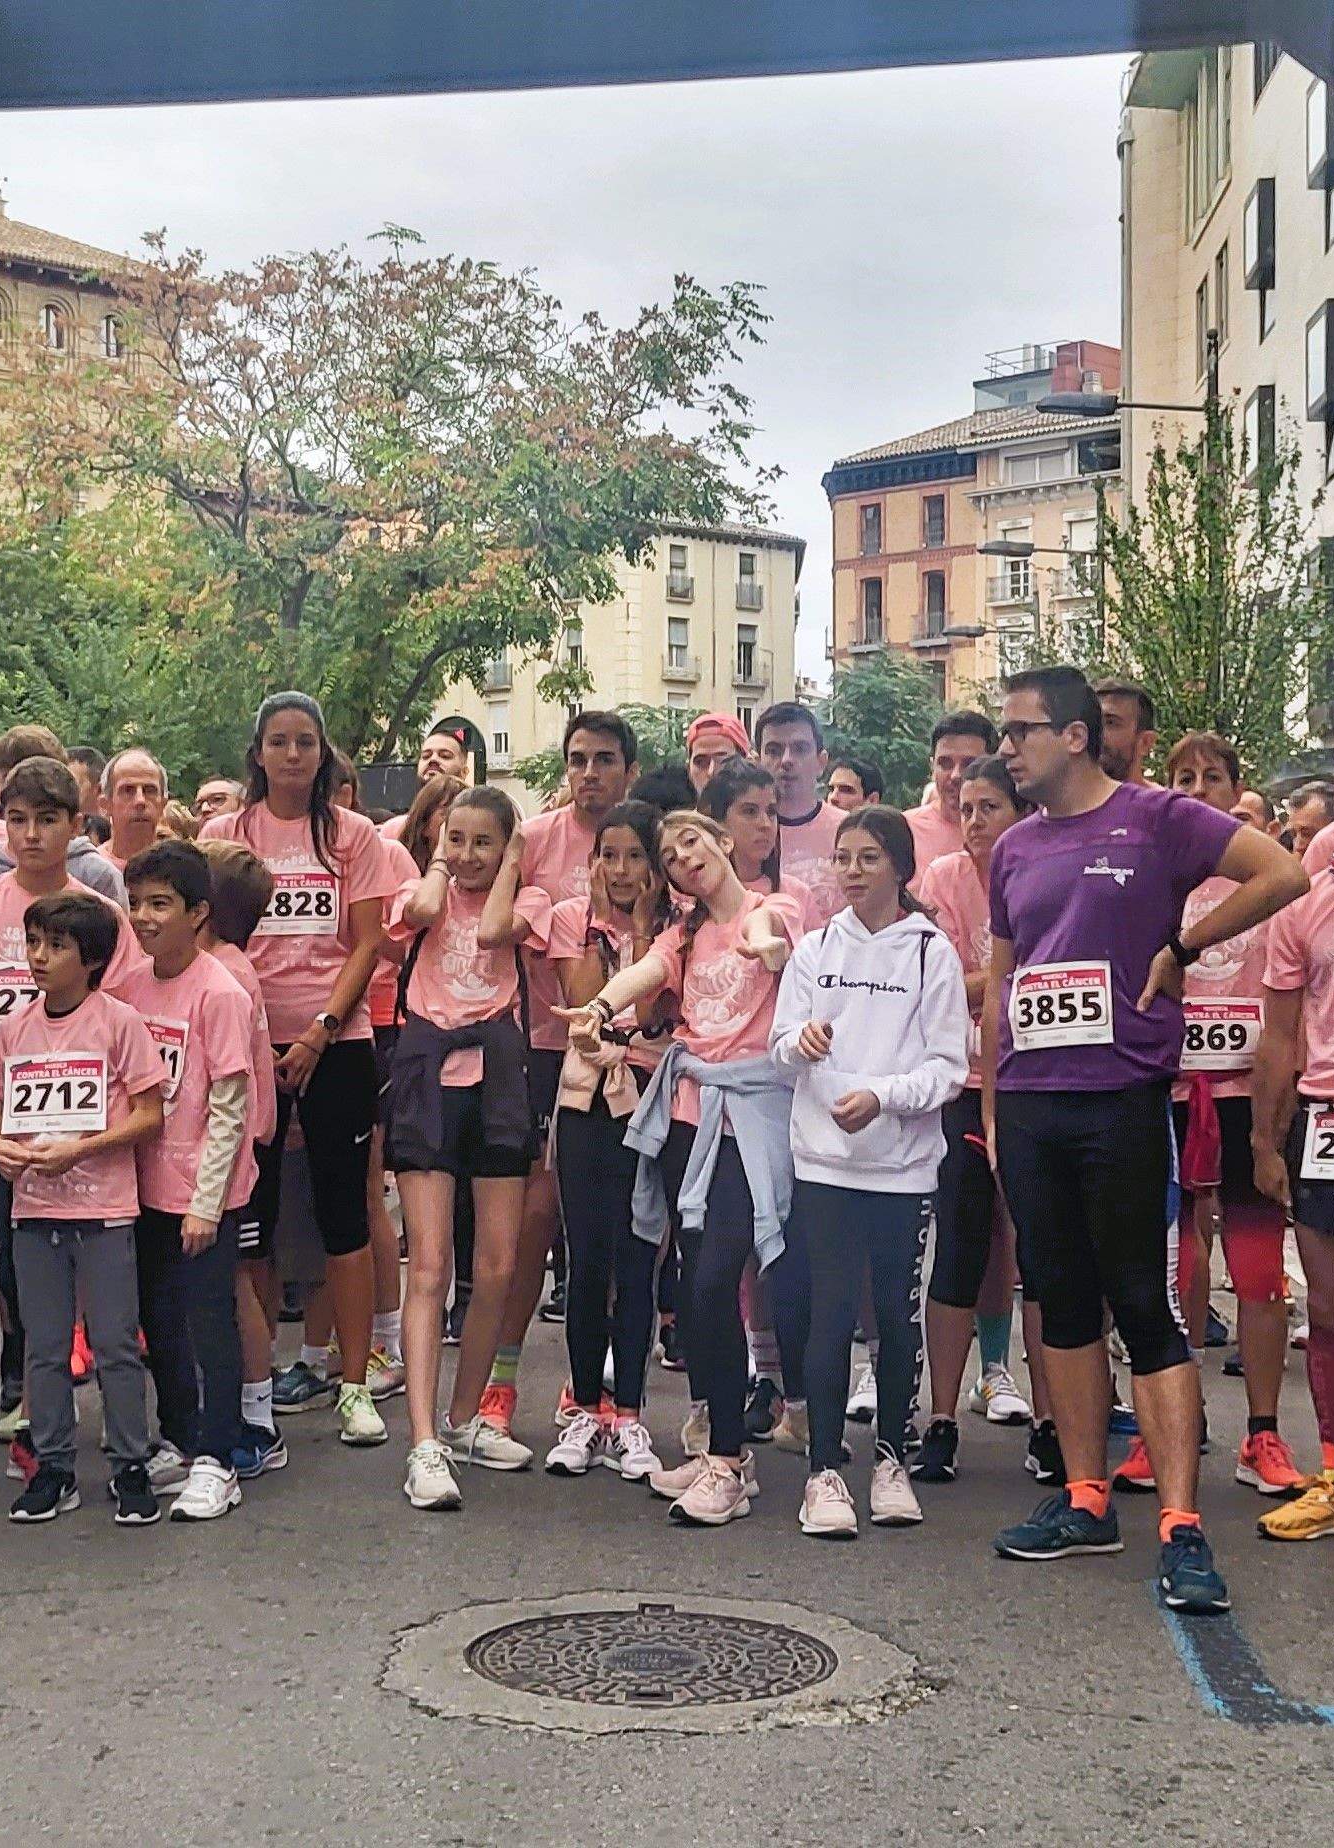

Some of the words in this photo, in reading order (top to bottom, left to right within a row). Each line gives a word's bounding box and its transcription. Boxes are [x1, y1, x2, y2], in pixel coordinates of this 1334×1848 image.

[264, 891, 333, 917] 828
[817, 974, 908, 996] Champion
[1051, 980, 1061, 989] EL
[1062, 975, 1101, 987] CÁNCER
[1018, 991, 1102, 1028] 3855
[1185, 1023, 1247, 1051] 869
[16, 1069, 50, 1079] CONTRA
[51, 1068, 61, 1077] EL
[62, 1066, 98, 1076] CÁNCER
[13, 1080, 98, 1113] 2712
